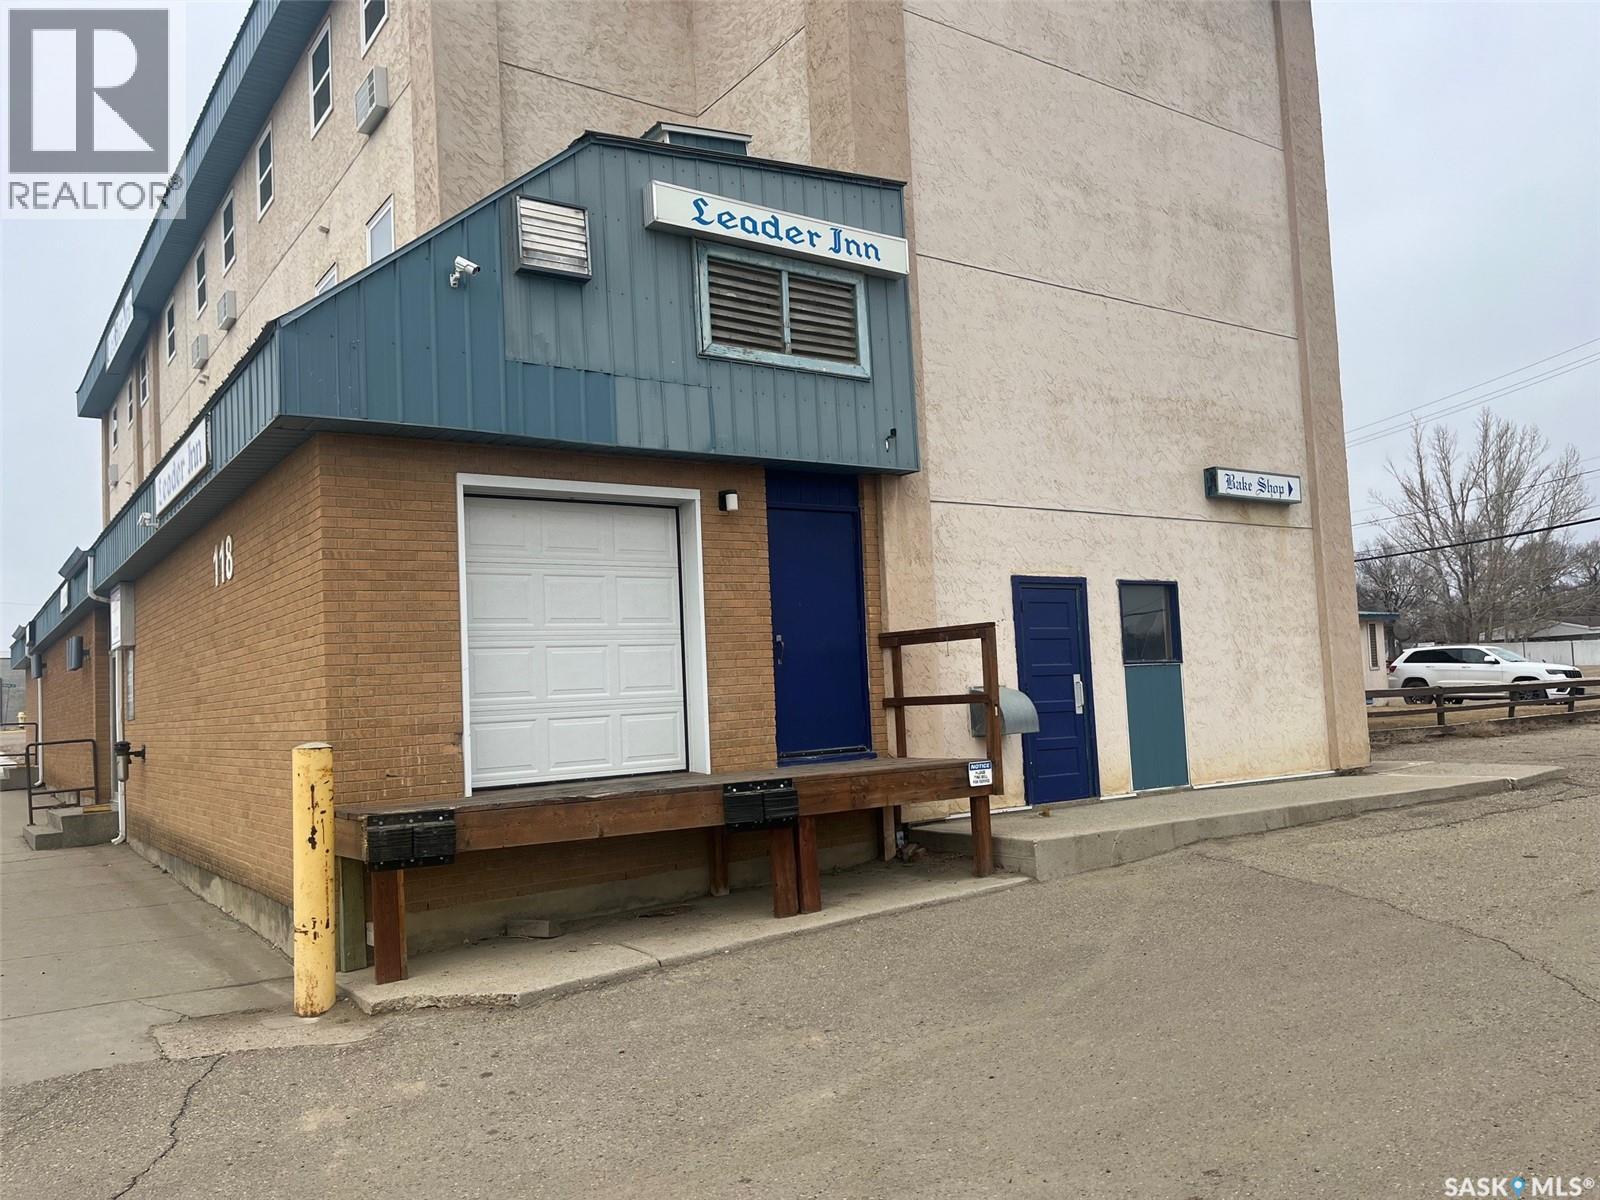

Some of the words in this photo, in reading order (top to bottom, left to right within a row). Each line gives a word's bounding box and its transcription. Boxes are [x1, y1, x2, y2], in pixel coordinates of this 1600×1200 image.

[691, 197, 822, 248] Leader
[828, 227, 881, 262] Inn
[1224, 473, 1253, 492] Bake
[1255, 476, 1285, 498] Shop
[213, 535, 233, 587] 118
